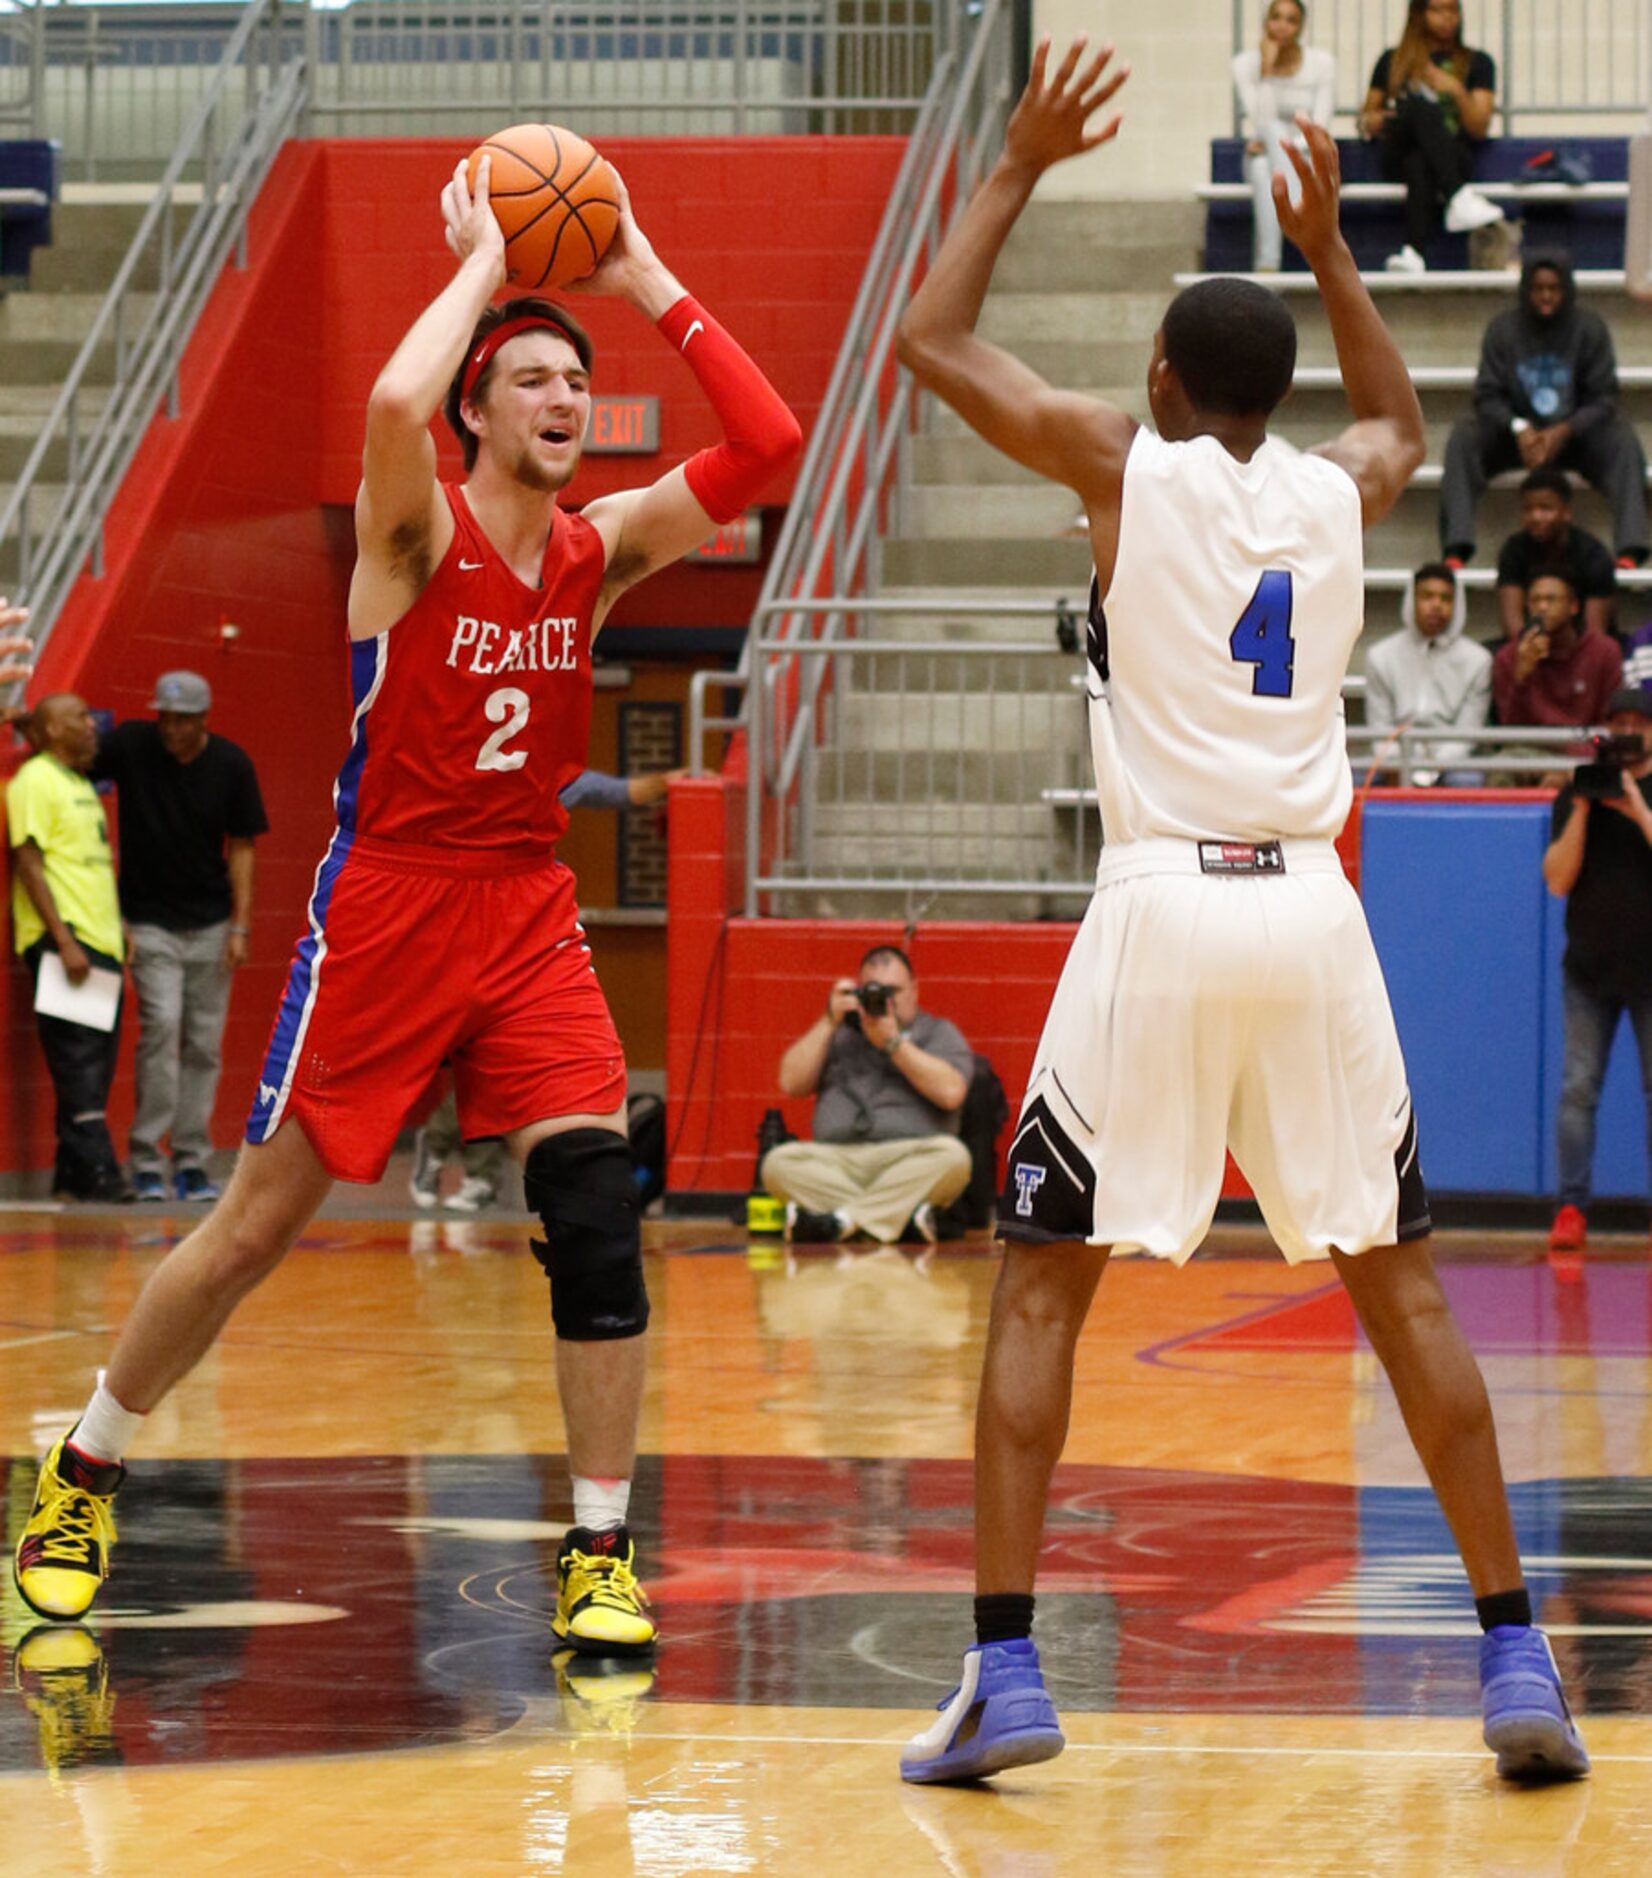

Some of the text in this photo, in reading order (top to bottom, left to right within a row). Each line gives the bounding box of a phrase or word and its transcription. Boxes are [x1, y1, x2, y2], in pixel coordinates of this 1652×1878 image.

[594, 403, 645, 444] EXIT
[1229, 570, 1295, 698] 4
[475, 687, 530, 772] 2
[1015, 1163, 1047, 1216] T
